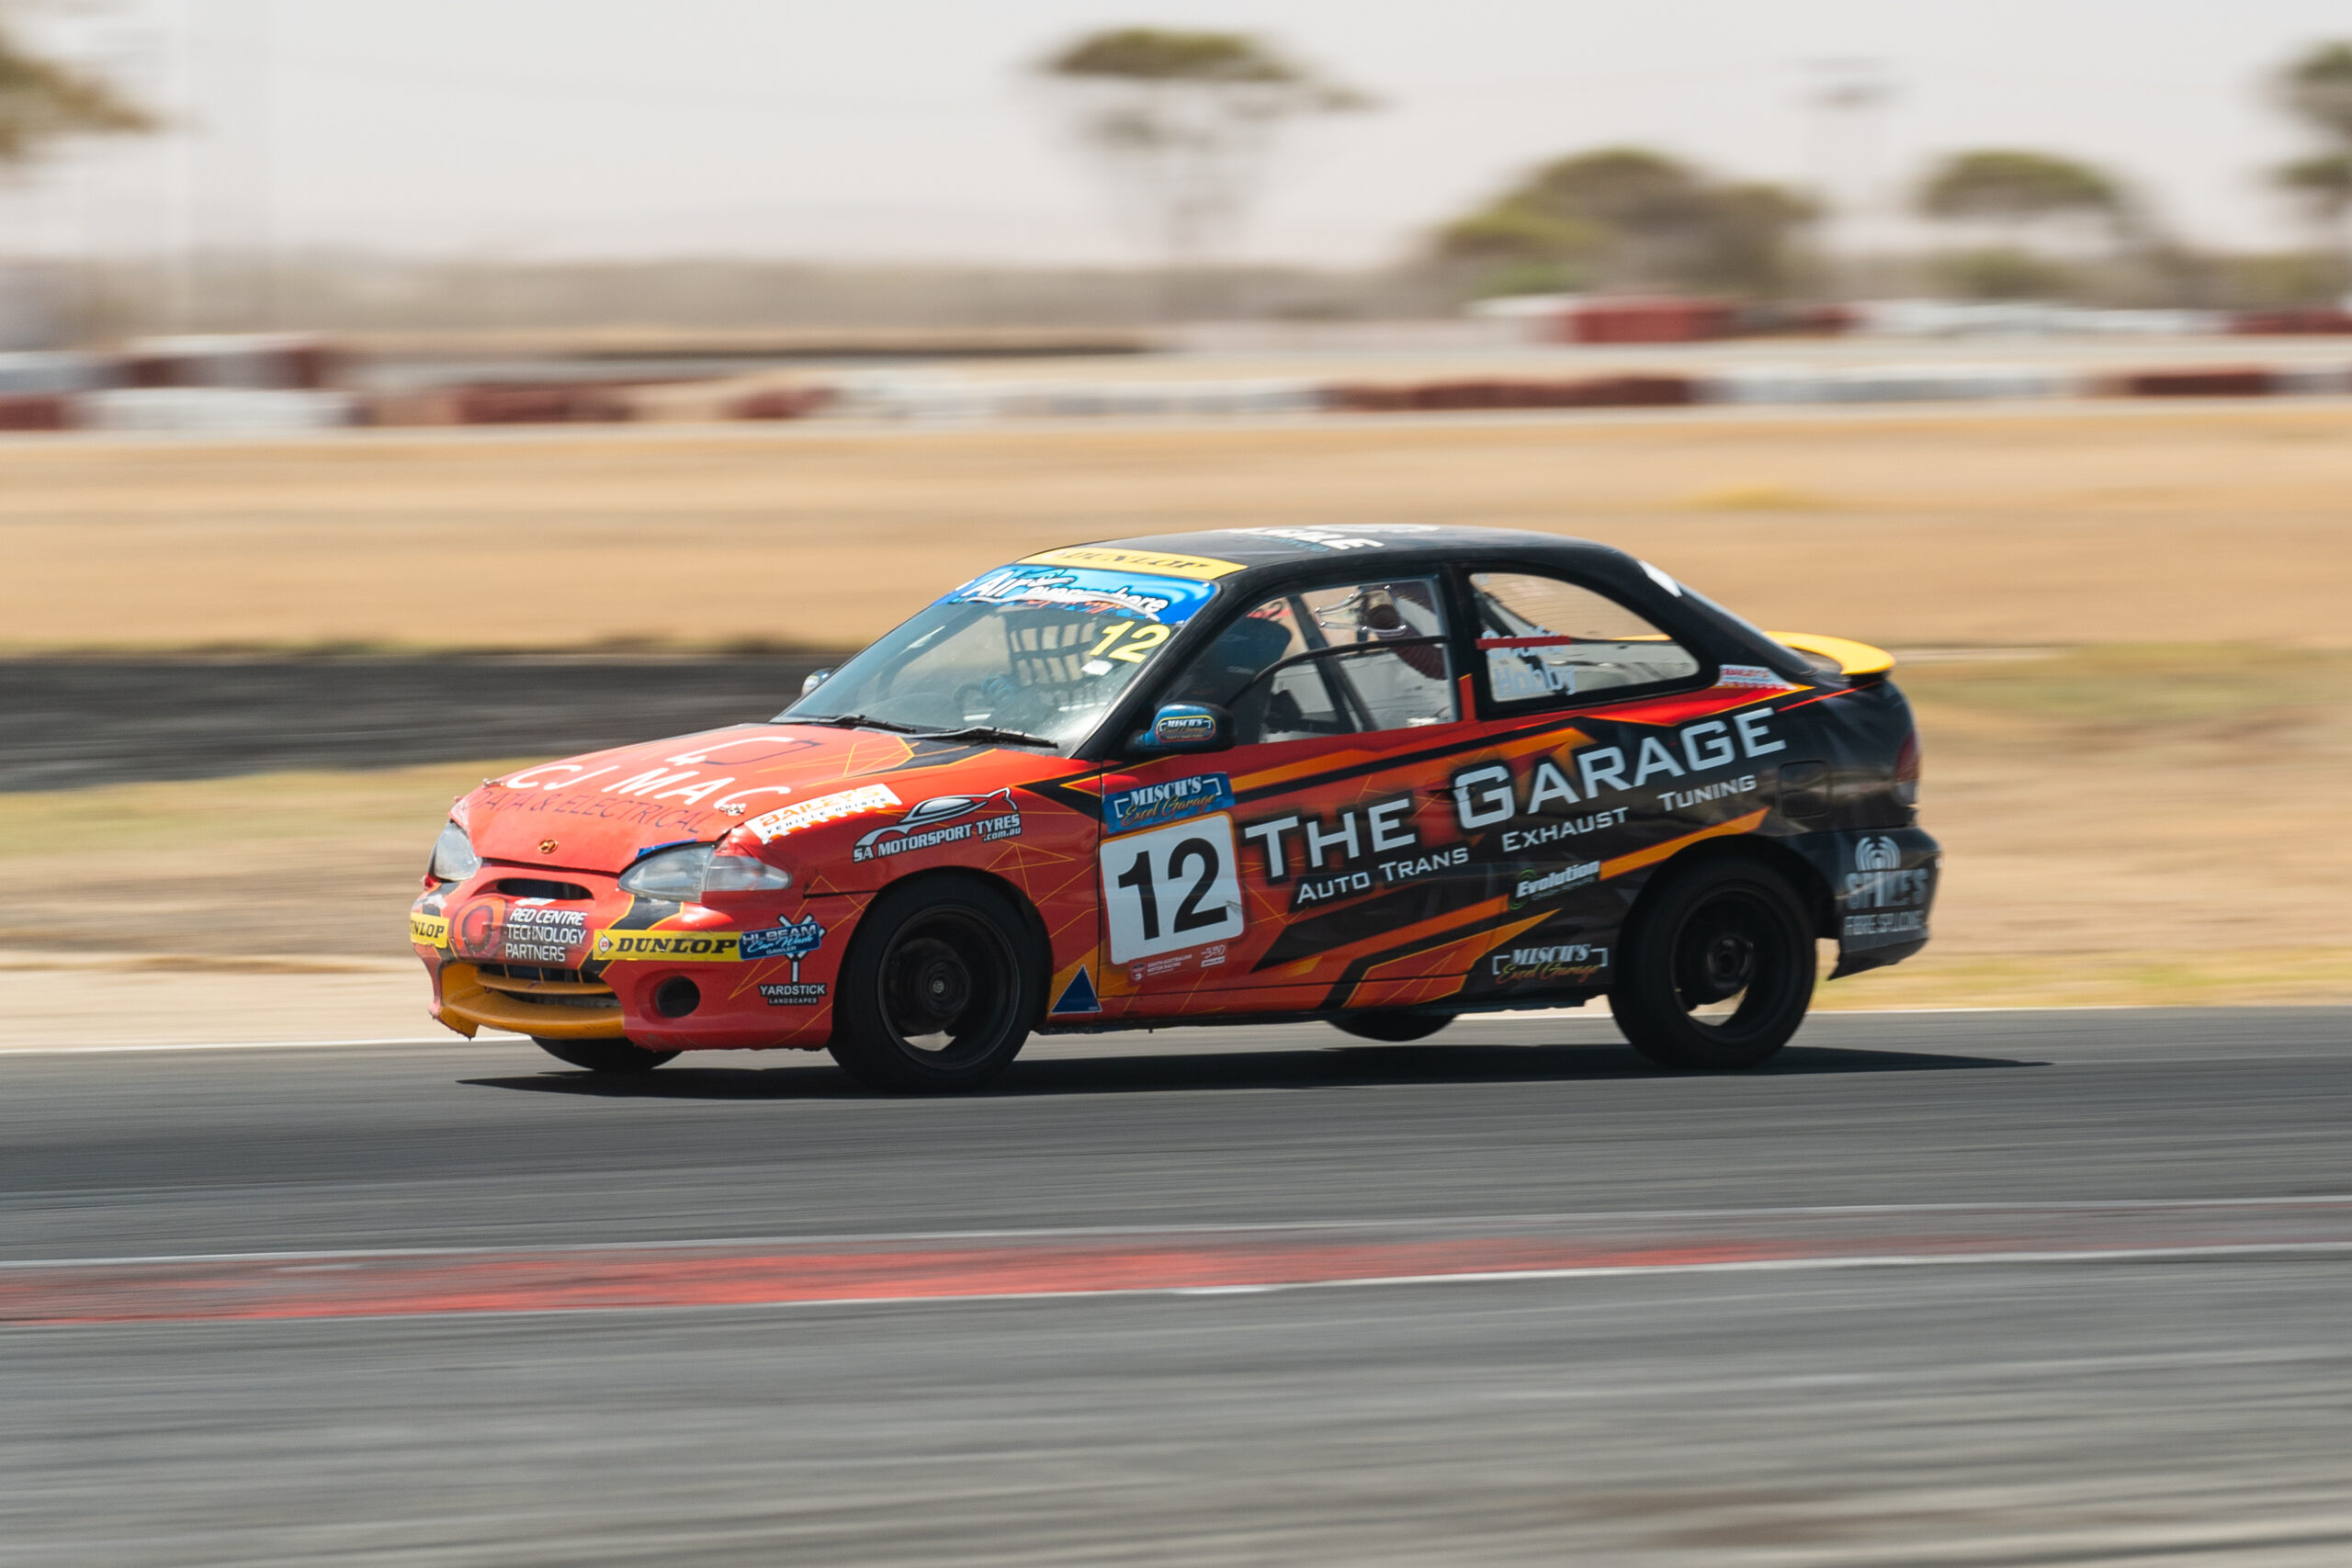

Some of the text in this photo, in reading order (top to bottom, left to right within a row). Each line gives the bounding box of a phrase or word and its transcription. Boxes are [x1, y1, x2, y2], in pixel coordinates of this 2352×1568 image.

[1089, 621, 1170, 663] 12
[506, 764, 791, 810] CJ MAC
[1130, 776, 1203, 807] MISCH'S
[1244, 707, 1786, 878] THE GARAGE
[555, 794, 715, 834] ELECTRICAL
[1121, 795, 1216, 827] Excel Garage
[854, 813, 1021, 863] SA MOTORSPORT TYRES
[983, 827, 1022, 841] .com.au
[1296, 775, 1758, 904] AUTO TRANS EXHAUST TUNING
[1117, 837, 1228, 941] 12
[1516, 860, 1600, 898] Evolution
[411, 919, 445, 938] NLOP
[509, 908, 588, 926] RED CENTRE
[507, 924, 587, 944] TECHNOLOGY
[616, 938, 738, 954] DUNLOP
[742, 924, 817, 945] HI-BEAM
[747, 934, 814, 953] Car Wash
[505, 943, 566, 962] PARTNERS
[1511, 943, 1591, 965] MISCH'S
[760, 985, 826, 995] YARDSTICK
